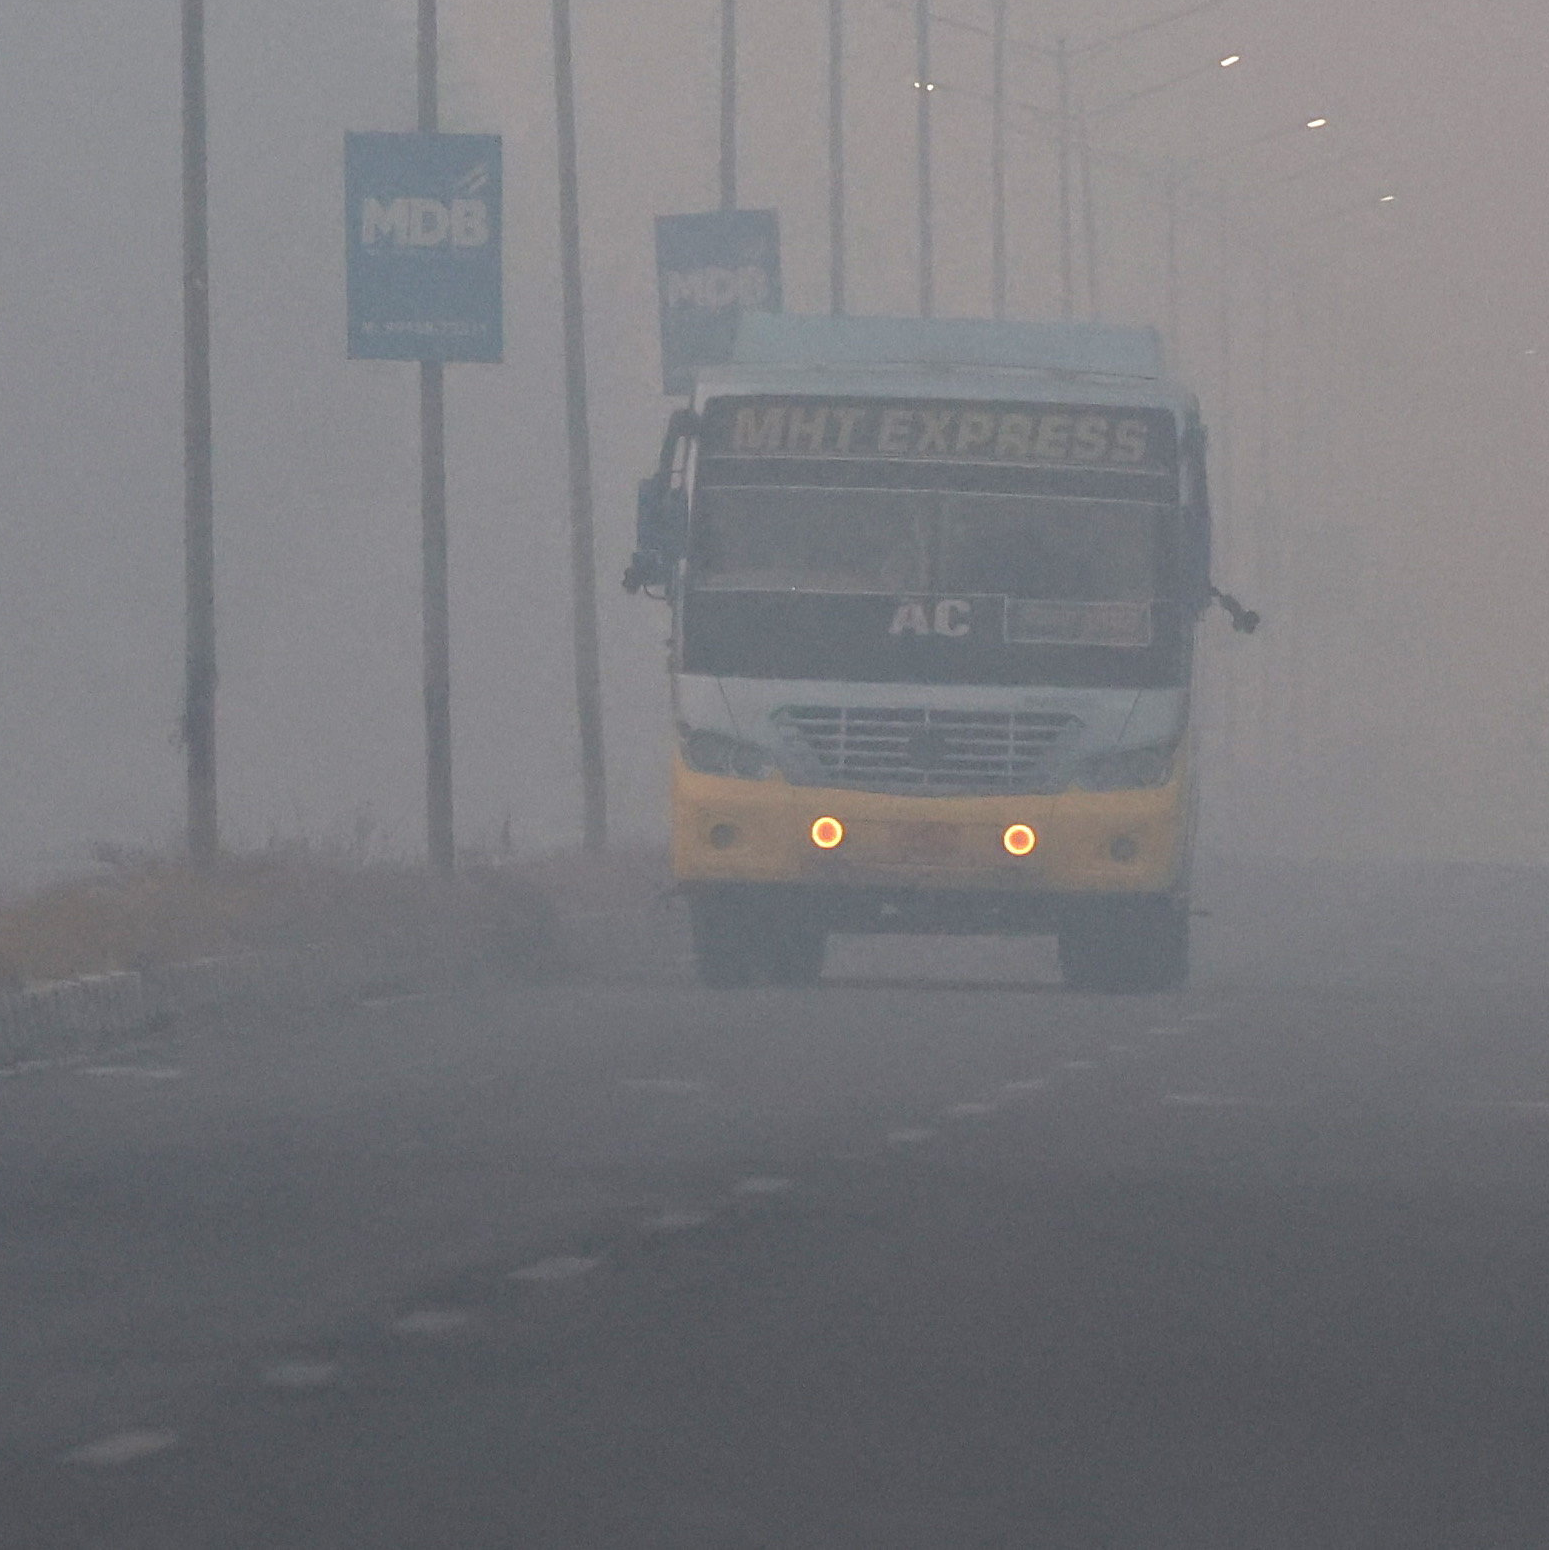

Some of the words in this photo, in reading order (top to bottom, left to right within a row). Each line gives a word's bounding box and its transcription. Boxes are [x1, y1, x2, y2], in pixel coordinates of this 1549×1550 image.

[361, 196, 490, 248] MDB
[665, 265, 769, 308] MDB
[732, 406, 866, 453] MHT
[877, 408, 1149, 463] EXPRESS
[888, 599, 971, 638] AC
